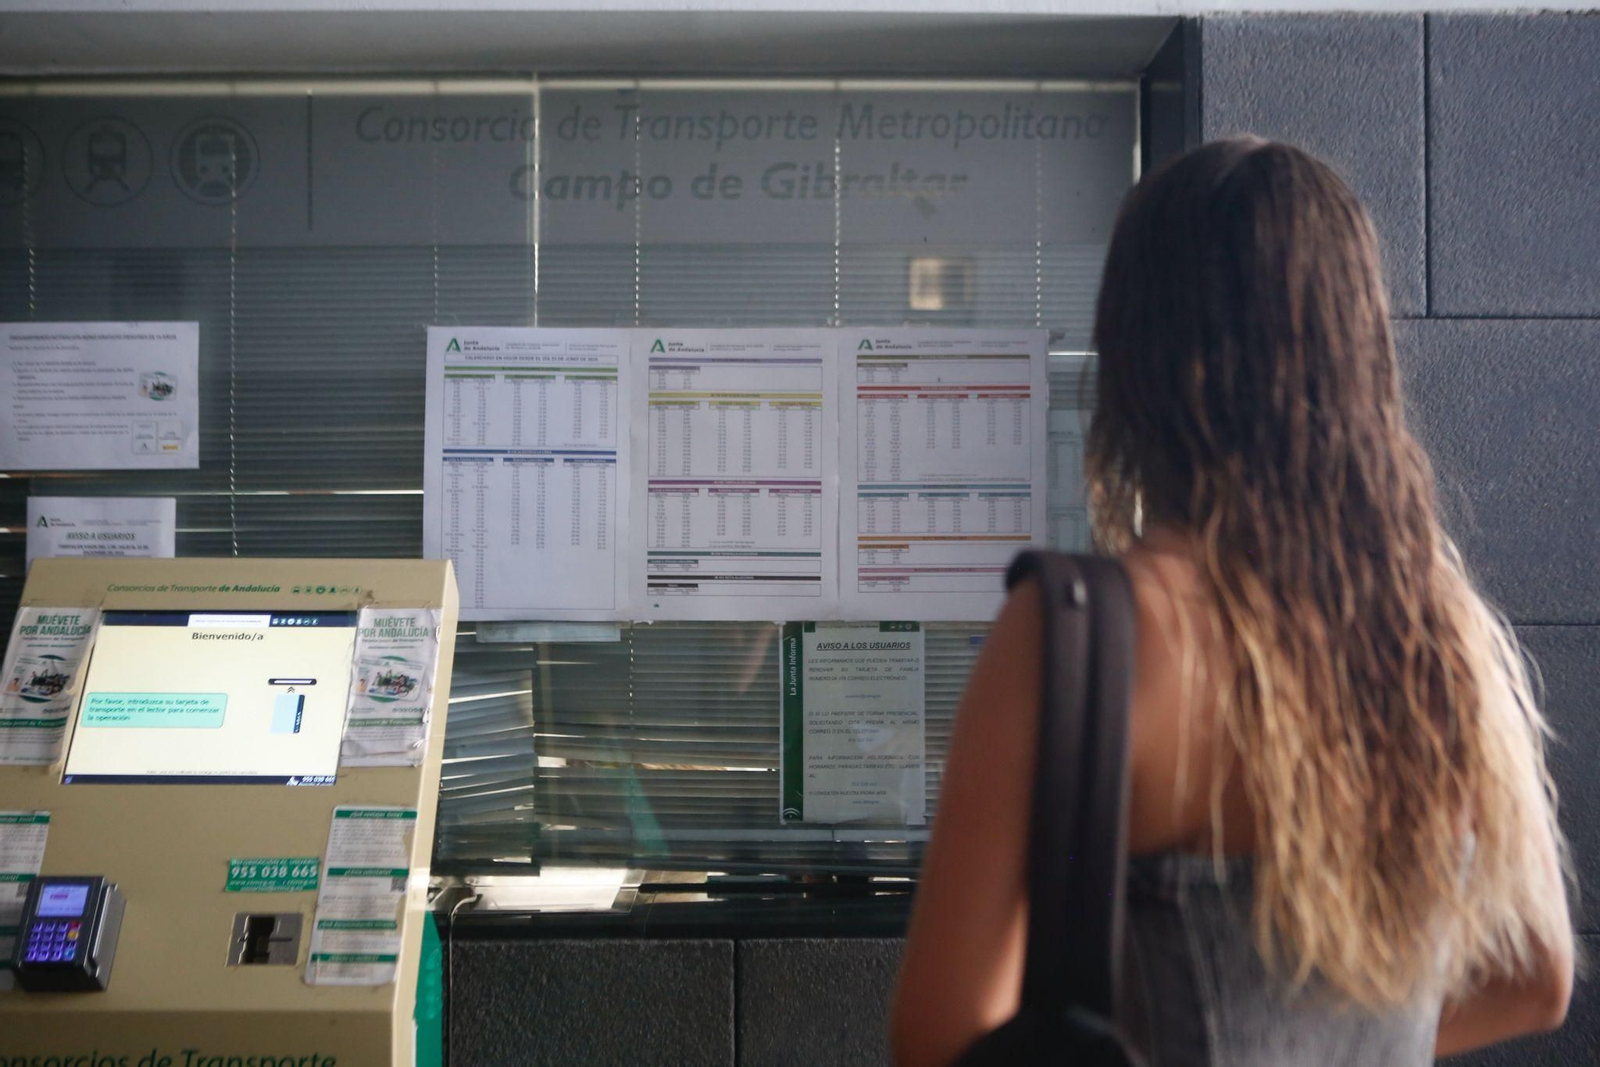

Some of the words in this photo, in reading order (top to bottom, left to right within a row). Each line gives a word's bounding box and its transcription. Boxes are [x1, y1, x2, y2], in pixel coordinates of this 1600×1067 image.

[354, 105, 540, 144] Consorcio
[556, 104, 602, 144] de
[613, 103, 819, 152] Transporte
[835, 102, 1106, 151] Metropolitano
[508, 163, 674, 211] Campo
[689, 162, 744, 202] de
[760, 162, 968, 203] Gibraltar
[107, 583, 156, 593] Consorcios
[157, 584, 168, 593] de
[170, 584, 218, 595] Transporte
[218, 584, 230, 594] de
[232, 584, 280, 594] Andalucía
[37, 613, 81, 626] MUÉVETE
[374, 616, 416, 630] MUÉVETE
[19, 625, 38, 636] POR
[39, 624, 92, 636] ANDALUCÍA
[192, 632, 264, 641] Bienvenido/a
[358, 628, 376, 640] POR
[378, 627, 428, 640] ANDALUCÍA
[789, 637, 797, 667] Informa
[816, 642, 842, 651] AVISO
[842, 642, 849, 651] A
[851, 642, 868, 651] LOS
[869, 641, 912, 651] USUARIOS
[789, 667, 797, 687] Junta
[789, 687, 797, 696] La
[175, 698, 198, 706] tarjeta
[89, 706, 126, 714] transporte
[95, 714, 130, 722] operación
[231, 865, 258, 879] 955
[260, 865, 289, 878] 038
[291, 864, 318, 878] 665
[136, 1047, 173, 1067] de
[180, 1047, 338, 1067] Transporte
